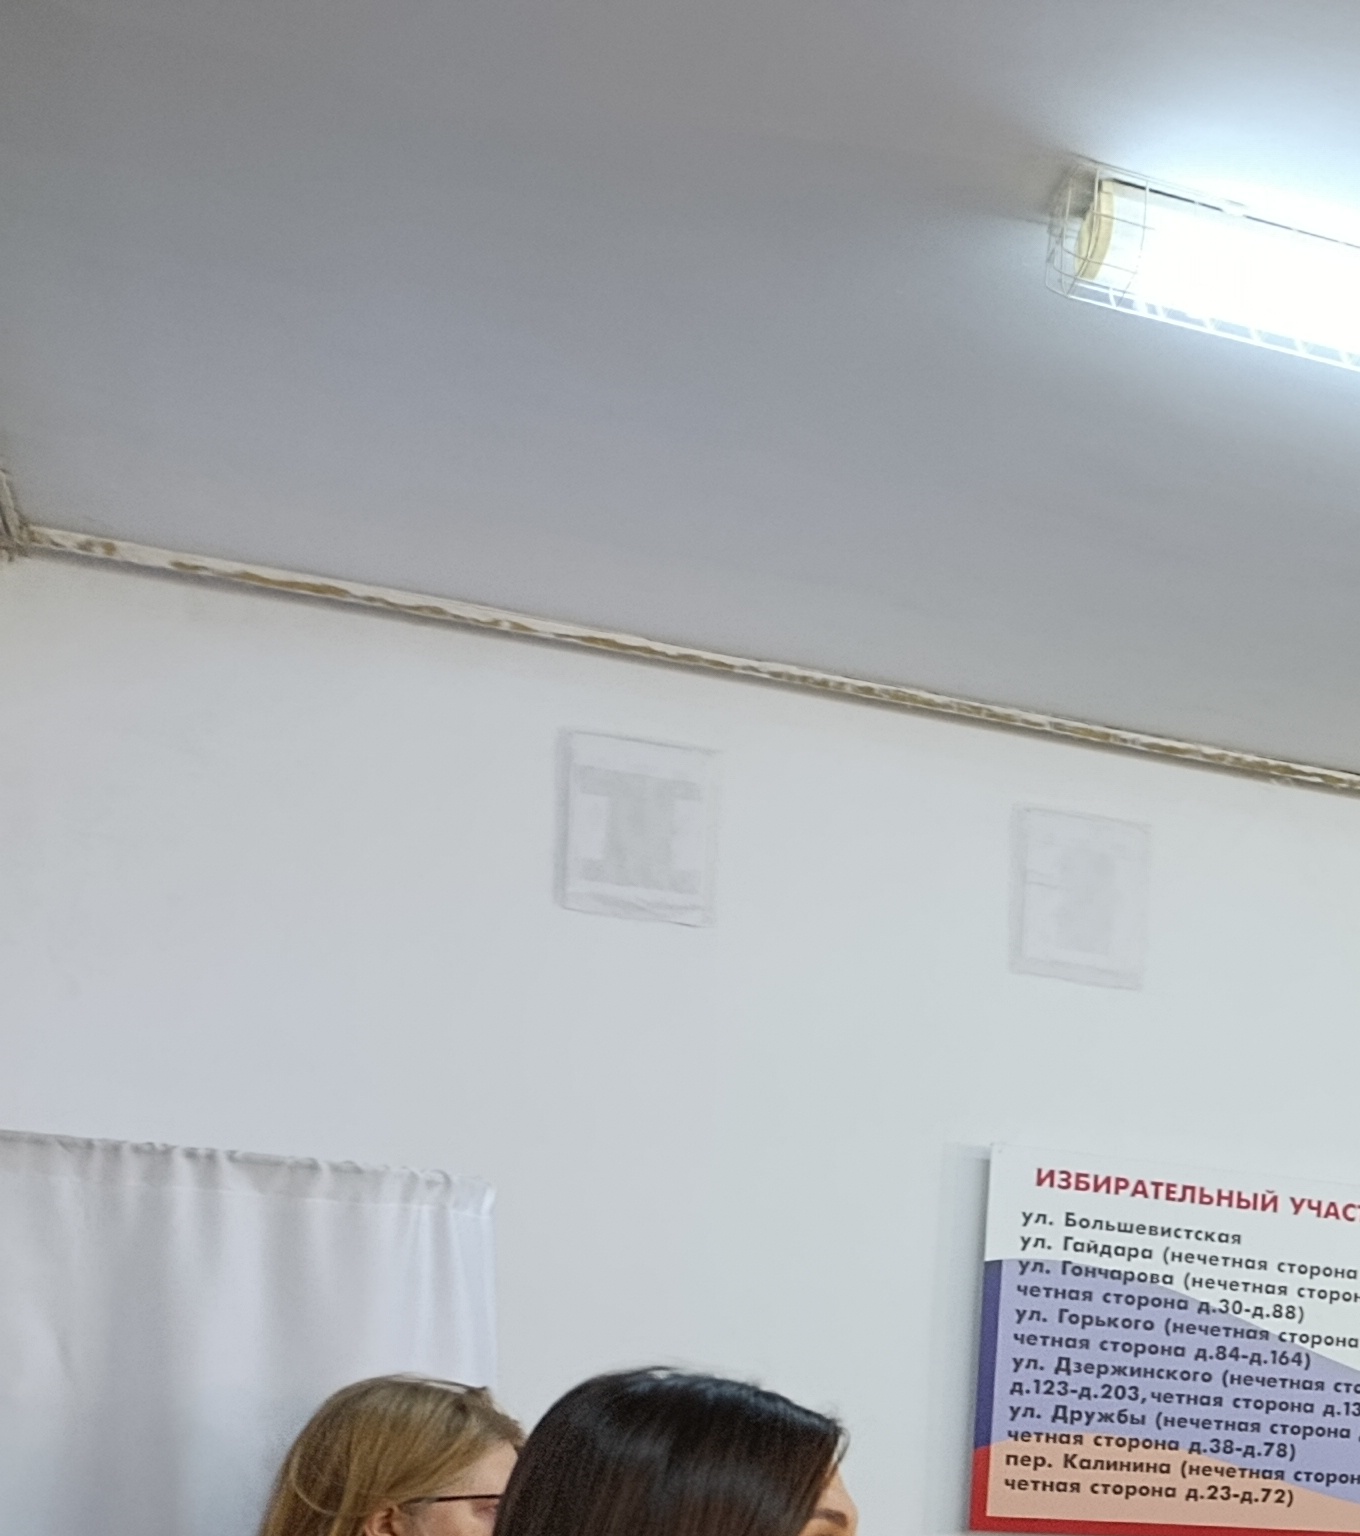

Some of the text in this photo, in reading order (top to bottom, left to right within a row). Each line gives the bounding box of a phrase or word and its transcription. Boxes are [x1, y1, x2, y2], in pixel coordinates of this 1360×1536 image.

[1036, 1168, 1278, 1213] ИЗБИРАТЕЛЬНЫЙ
[1022, 1212, 1241, 1244] ул. Большевистская
[1020, 1236, 1052, 1251] ул.
[1063, 1236, 1153, 1262] Гайдара
[1163, 1246, 1268, 1270] (нечетная
[1277, 1262, 1358, 1280] сторона
[1018, 1260, 1050, 1276] ул.
[1062, 1260, 1174, 1285] Гончарова
[1184, 1272, 1288, 1296] (нечетная
[1017, 1284, 1304, 1324] четная сторона д.30-д.88)
[1015, 1309, 1048, 1324] ул.
[1058, 1308, 1154, 1331] Горького
[1164, 1318, 1270, 1340] (нечетная
[1278, 1332, 1359, 1348] сторона
[1014, 1333, 1311, 1371] четная сторона д.84-д.164)
[1012, 1358, 1045, 1373] ул.
[1054, 1356, 1212, 1382] Дзержинского
[1222, 1370, 1325, 1391] (нечетная
[1009, 1406, 1042, 1422] ул.
[1051, 1405, 1146, 1426] Дружбы
[1156, 1412, 1261, 1433] (нечетная
[1270, 1424, 1350, 1440] сторона
[1232, 1398, 1314, 1414] сторона
[1007, 1430, 1296, 1462] четная сторона д.38-д.78)
[1006, 1454, 1053, 1471] пер.
[1063, 1454, 1170, 1474] Калинина
[1181, 1460, 1285, 1480] (нечетная
[1004, 1478, 1294, 1508] четная сторона д.23-д.72)
